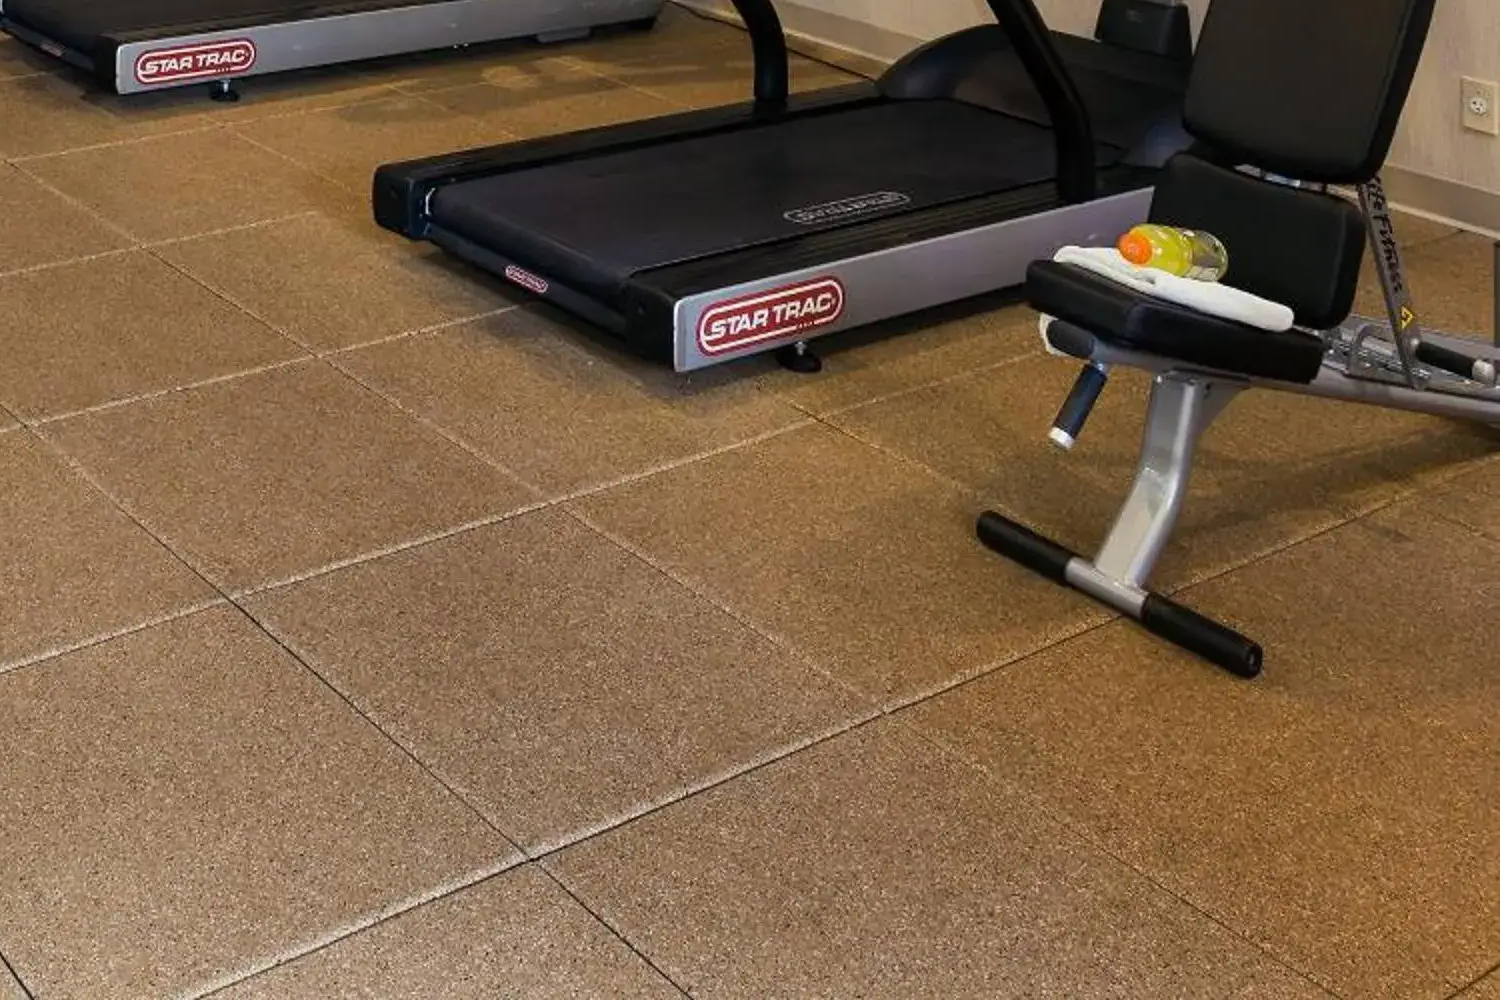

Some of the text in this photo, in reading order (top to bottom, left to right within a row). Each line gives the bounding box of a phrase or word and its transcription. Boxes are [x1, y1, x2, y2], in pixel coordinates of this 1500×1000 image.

[145, 49, 246, 74] STAR TRAC
[710, 293, 834, 337] STAR TRAC
